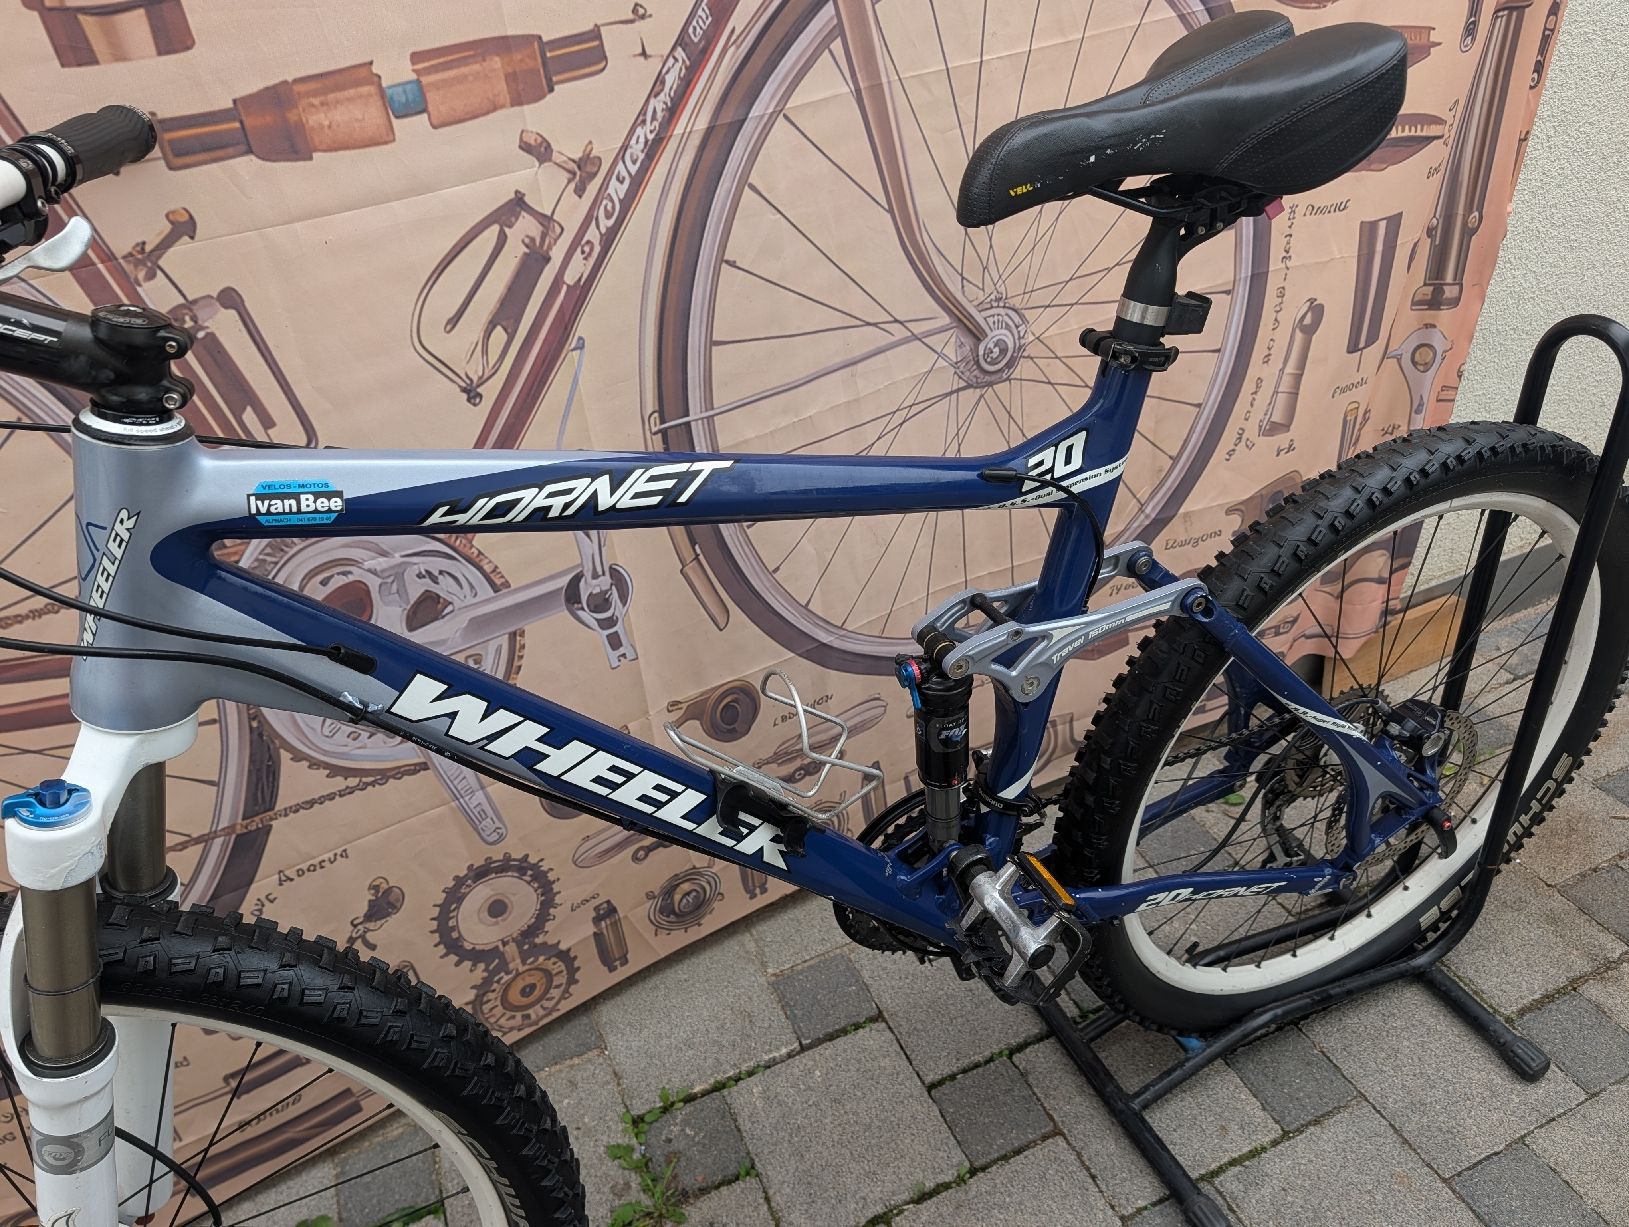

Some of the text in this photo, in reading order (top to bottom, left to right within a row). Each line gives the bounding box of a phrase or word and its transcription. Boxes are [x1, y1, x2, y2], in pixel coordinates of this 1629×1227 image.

[0, 323, 58, 344] CEPT
[1021, 430, 1087, 493] 20
[249, 493, 343, 514] Ivan Bee
[419, 460, 735, 528] HORNET
[80, 508, 141, 662] WHEELER
[1052, 636, 1084, 664] Travel
[389, 672, 789, 871] WHEELER
